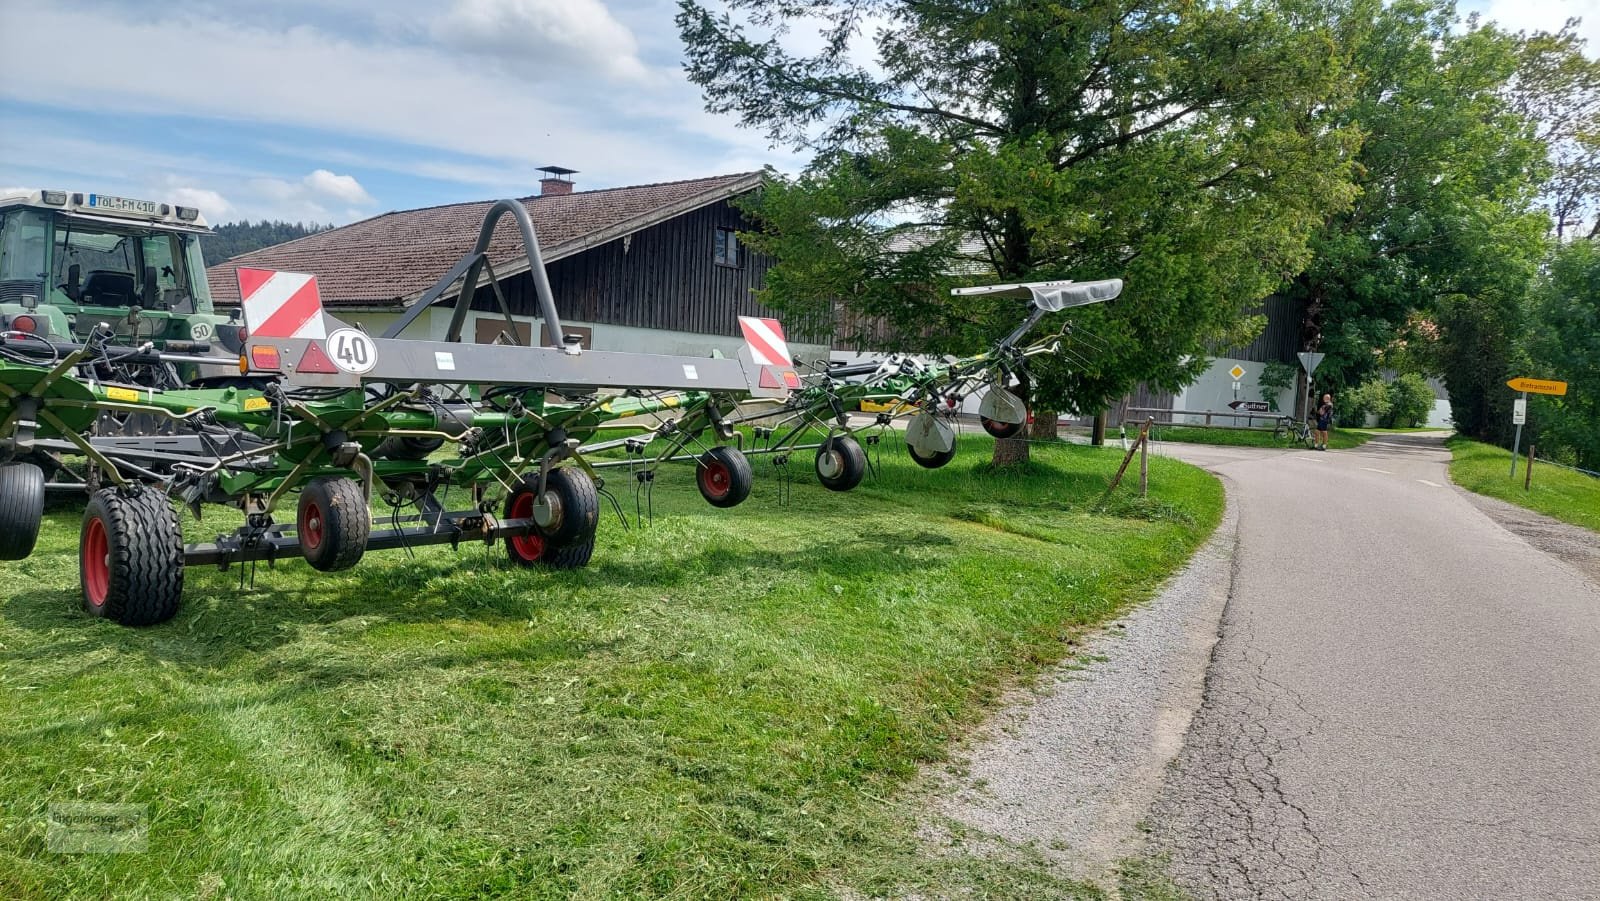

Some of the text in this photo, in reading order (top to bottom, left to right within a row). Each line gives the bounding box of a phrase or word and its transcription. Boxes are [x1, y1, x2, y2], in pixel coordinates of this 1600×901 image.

[122, 200, 135, 210] FM
[137, 201, 154, 212] 410
[193, 324, 209, 339] 50
[337, 335, 368, 365] 40
